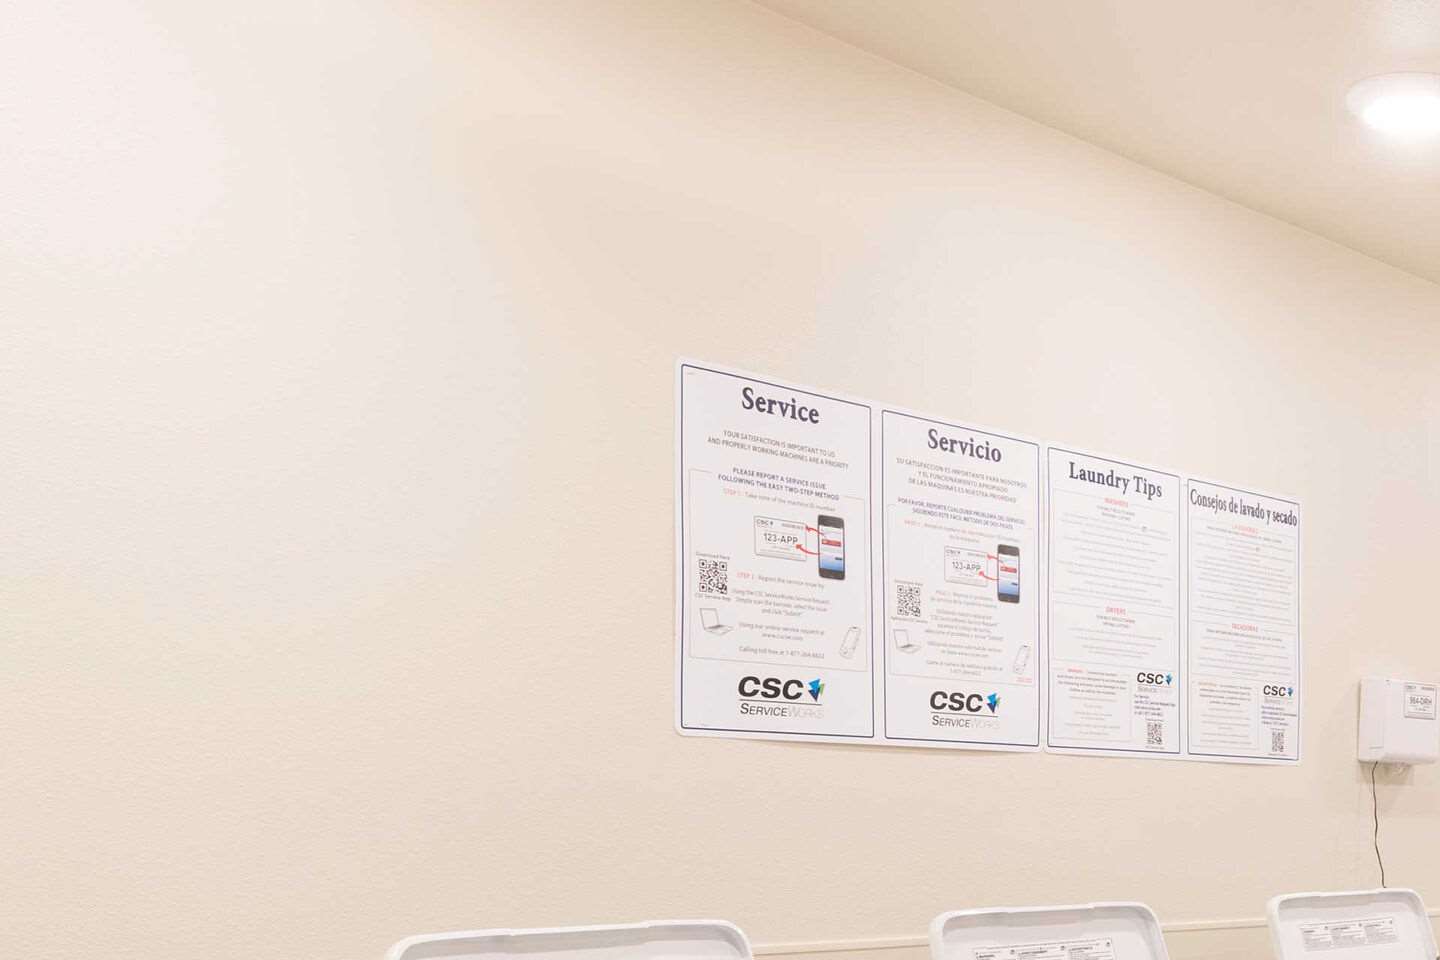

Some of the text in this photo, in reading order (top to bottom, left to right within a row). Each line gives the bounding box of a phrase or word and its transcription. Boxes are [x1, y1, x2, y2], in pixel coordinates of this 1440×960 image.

[742, 387, 819, 424] Service
[708, 436, 848, 470] AND PROPERLY WORKING MACHINES ARE PRIORITY
[724, 430, 827, 456] YOUR SATISFACTION IS IMPORTANT TO
[928, 428, 1002, 462] Servicio
[733, 467, 808, 487] PLEASE REPORT A SERVICE
[952, 468, 984, 480] IMPORTANTE
[1069, 461, 1162, 500] Laundry Tips
[718, 474, 839, 500] FOLLOWING THE EASY TWO-STEP METHOD
[1190, 488, 1297, 527] Consejos de lavado y secado
[763, 532, 798, 545] 123-APP
[952, 561, 982, 572] 123-APP
[738, 675, 804, 700] CSC
[1136, 672, 1164, 685] CSC
[1263, 685, 1286, 697] CSC
[930, 690, 983, 712] CSC
